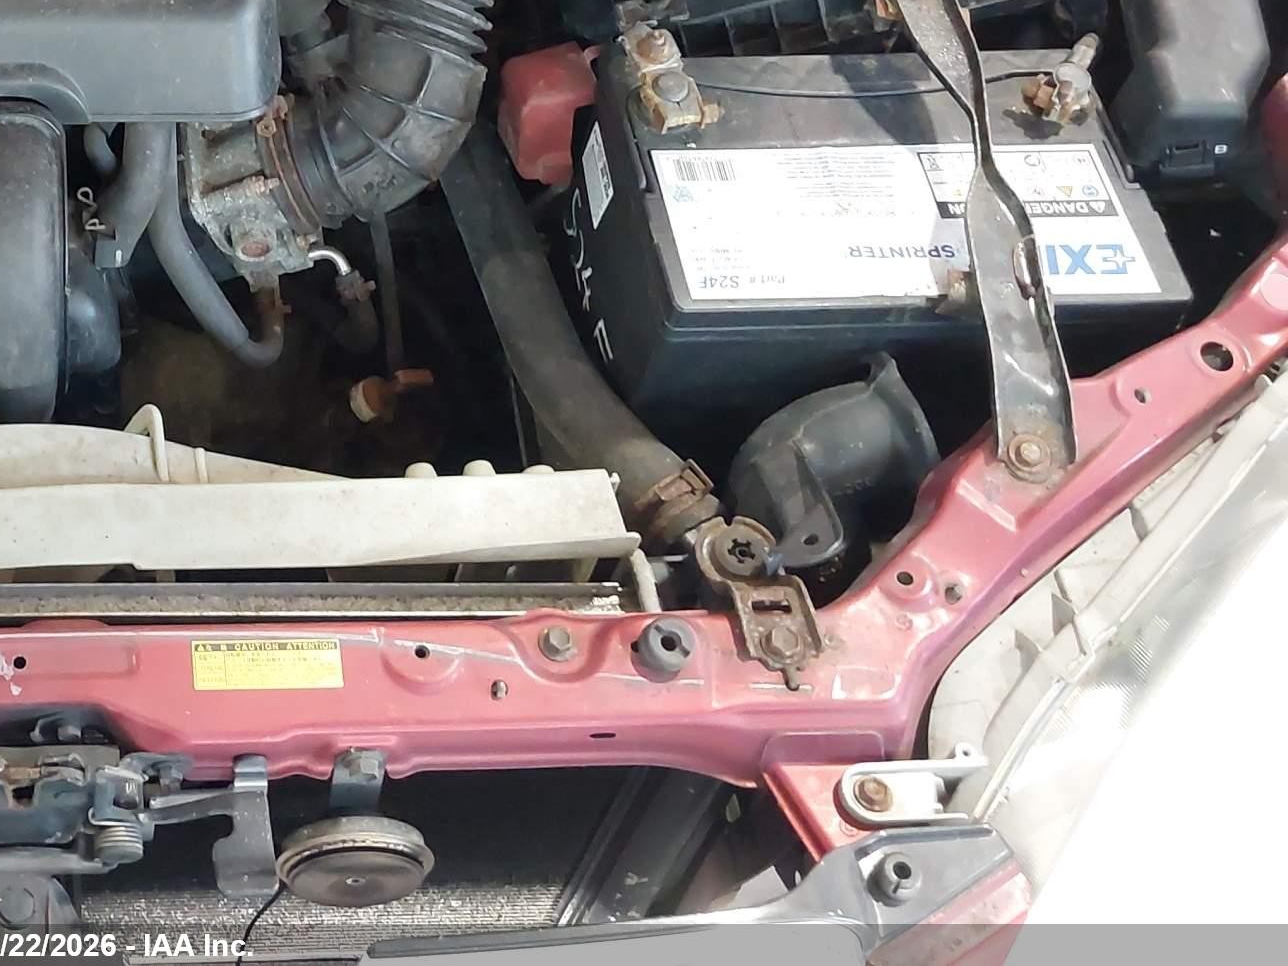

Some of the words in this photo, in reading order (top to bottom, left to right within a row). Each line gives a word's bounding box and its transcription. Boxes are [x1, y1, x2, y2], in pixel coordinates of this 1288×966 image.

[848, 244, 956, 259] SPRINTER
[1045, 245, 1136, 275] EXI
[698, 274, 740, 290] S24F
[234, 642, 280, 651] CAUTION
[286, 641, 336, 651] ATTENTION
